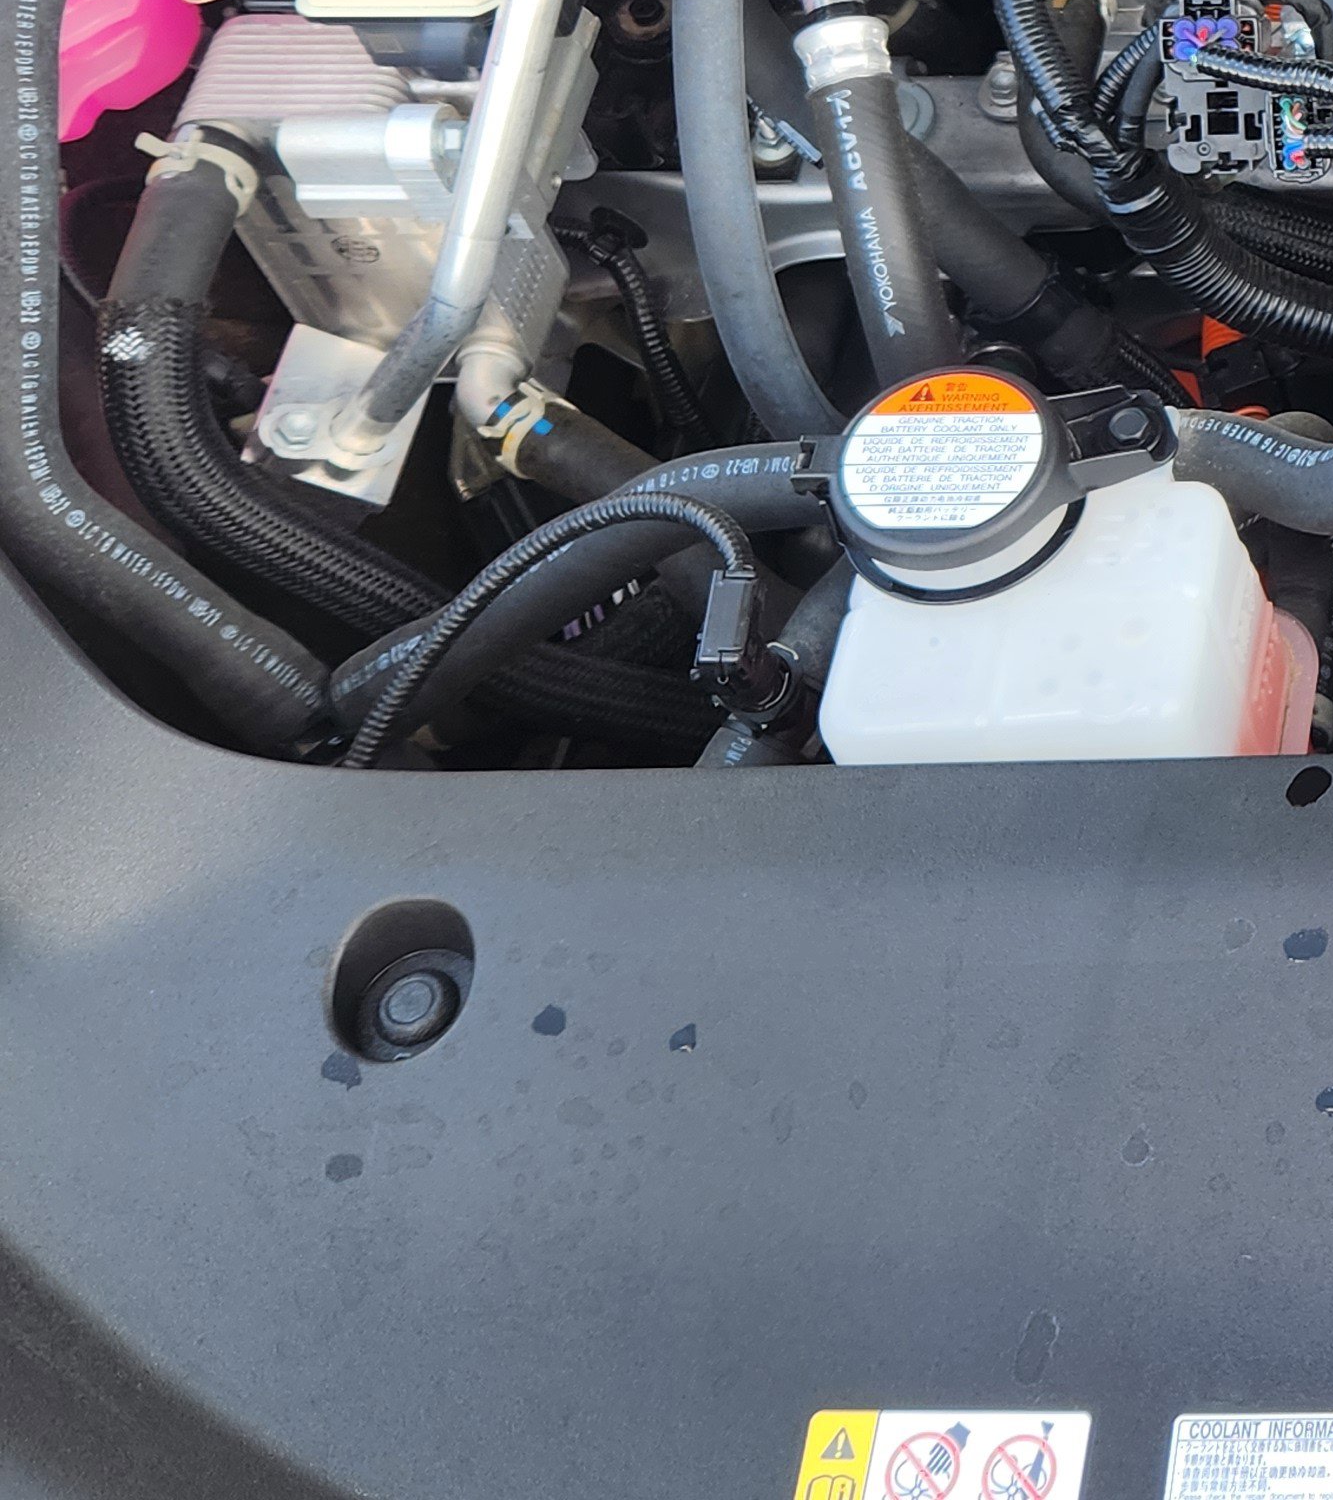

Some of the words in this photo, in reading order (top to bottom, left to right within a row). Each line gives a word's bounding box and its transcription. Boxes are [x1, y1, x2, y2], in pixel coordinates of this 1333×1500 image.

[19, 184, 41, 230] WATER
[866, 206, 898, 312] YOKOHAMA
[942, 393, 1000, 402] WARNING
[898, 402, 1008, 412] AVERTISSEMENT
[21, 393, 42, 439] WATER
[953, 416, 1004, 424] TRACTION
[881, 425, 927, 433] BATTERY
[933, 425, 983, 433] COOLANT
[989, 424, 1018, 432] ONLY
[1221, 421, 1264, 447] WATER
[863, 437, 904, 445] LIQUIDE
[910, 437, 924, 445] DE
[931, 436, 1029, 444] REFROIDISSEMENT
[862, 446, 892, 454] POUR
[898, 445, 946, 453] BATTERIE
[953, 445, 967, 453] DE
[866, 454, 941, 462] AUTHENTIQUE
[856, 466, 897, 474] LIQUIDE
[924, 465, 1024, 473] REFROIDISSEMENT
[862, 475, 875, 483] DE
[930, 483, 1000, 491] UNIQUEMENT
[109, 539, 155, 581] WATER
[1189, 1421, 1261, 1439] COOLANT
[1269, 1492, 1305, 1500] document
